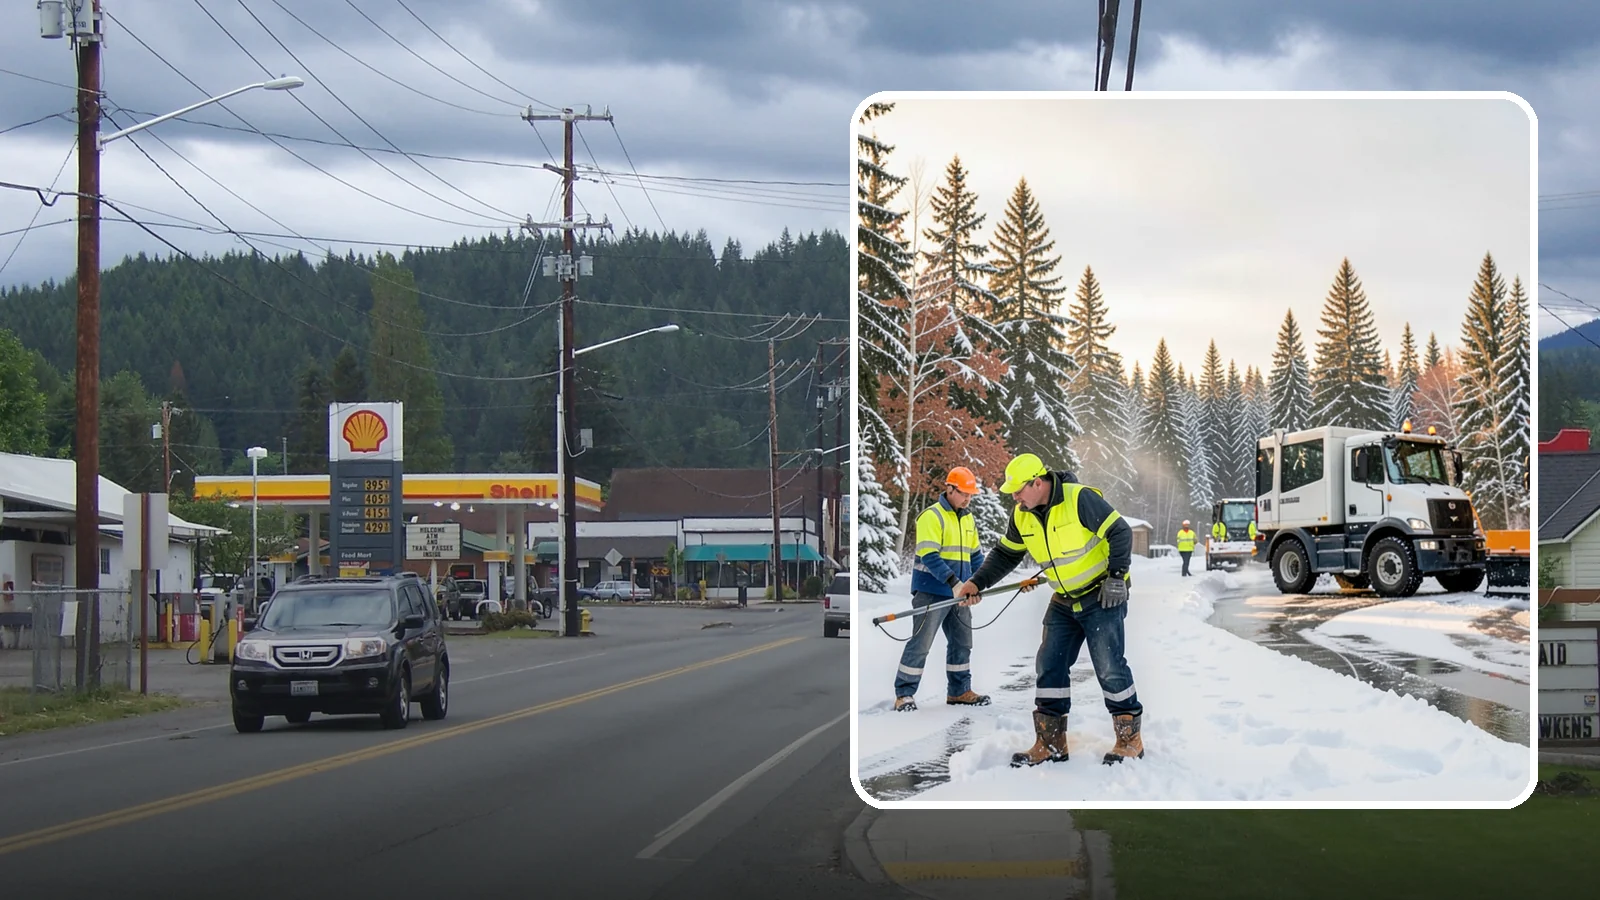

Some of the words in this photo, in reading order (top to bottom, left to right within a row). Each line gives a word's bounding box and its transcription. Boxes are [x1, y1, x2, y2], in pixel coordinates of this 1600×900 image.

[366, 480, 384, 490] 395
[490, 484, 547, 499] Shell
[366, 494, 384, 504] 405
[366, 508, 384, 518] 415
[366, 522, 384, 533] 429
